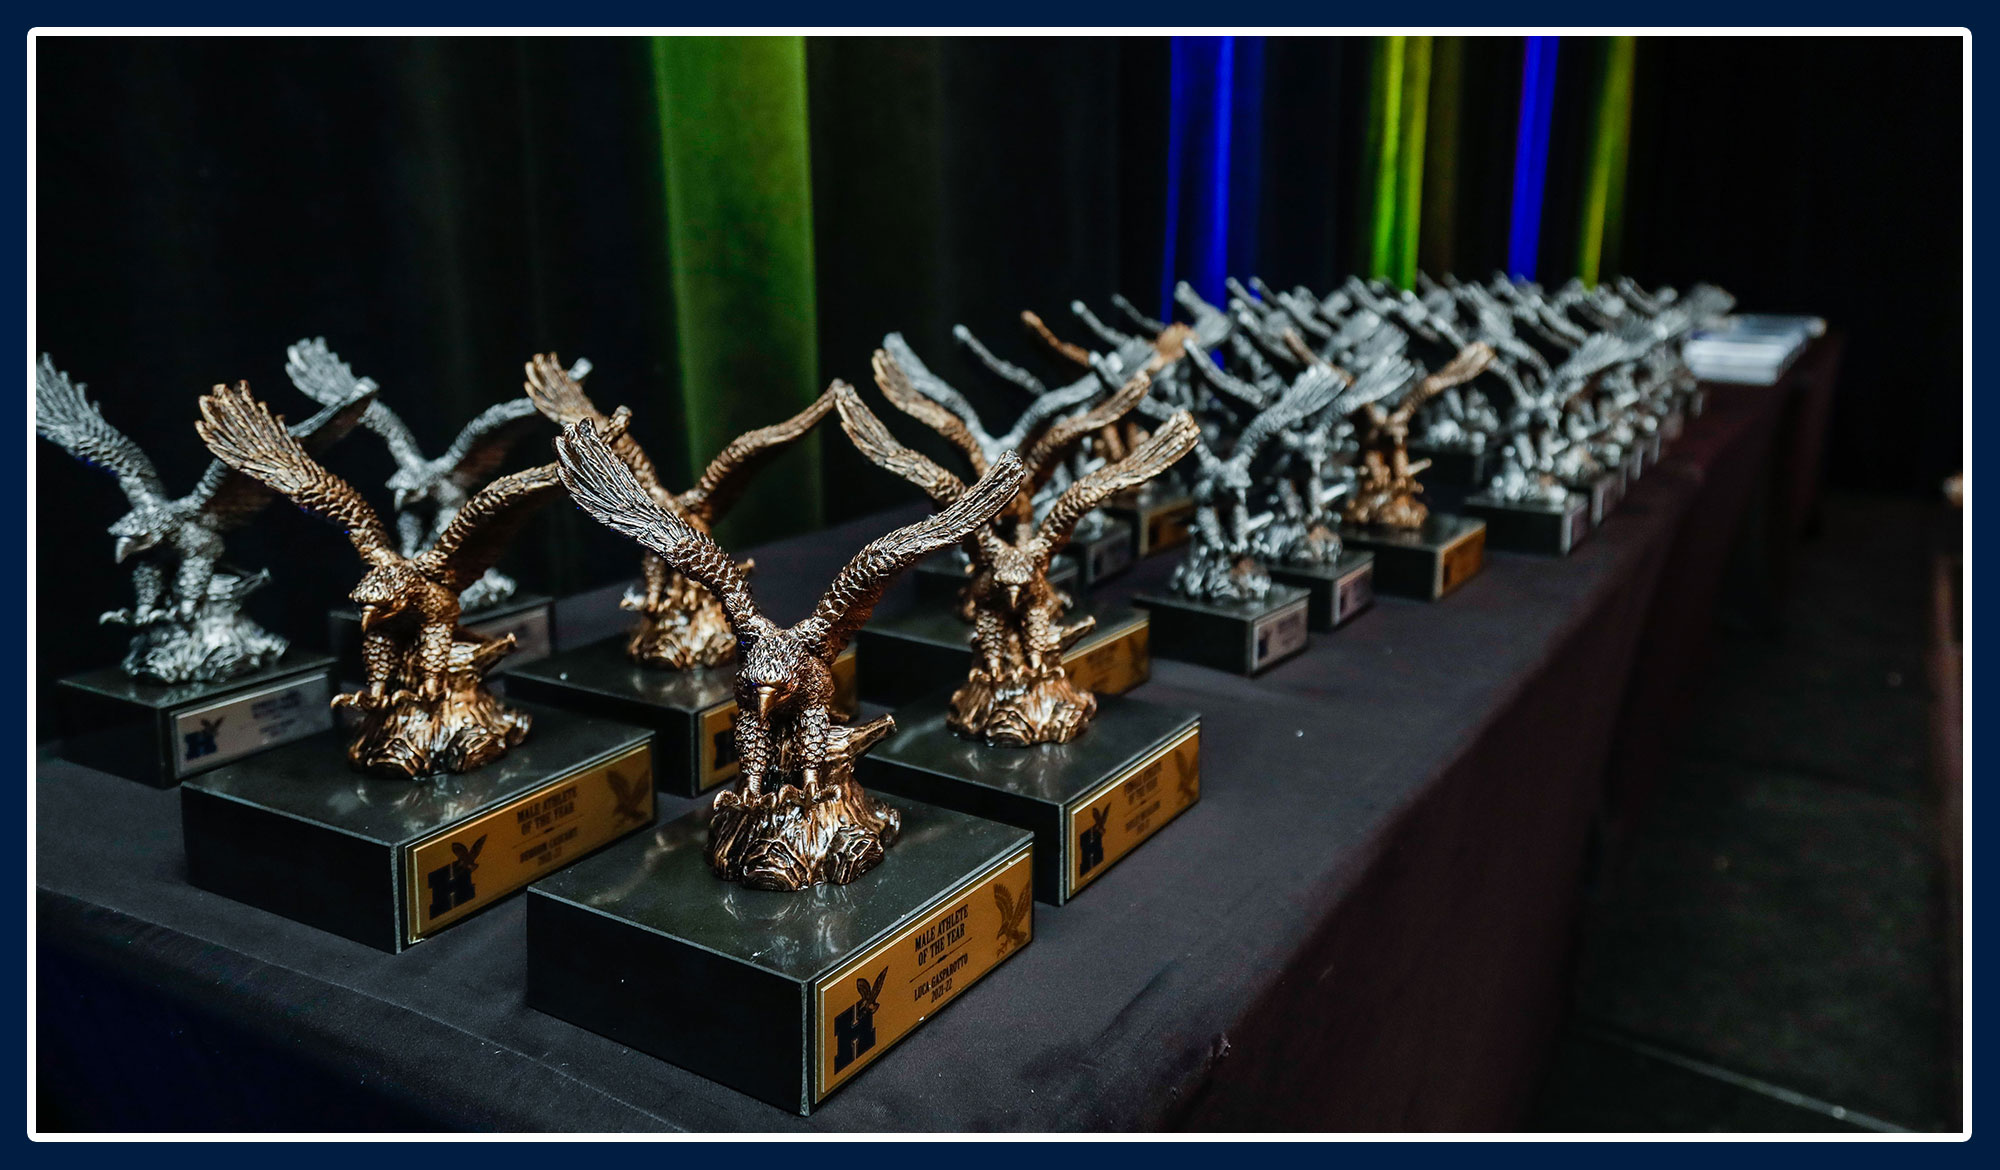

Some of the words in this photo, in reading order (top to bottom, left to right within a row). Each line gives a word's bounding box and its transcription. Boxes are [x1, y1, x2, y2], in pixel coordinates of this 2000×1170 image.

[517, 802, 541, 823] MALE
[535, 812, 552, 829] THE
[428, 864, 475, 920] H
[915, 927, 936, 952] MALE
[938, 905, 968, 936] ATHLETE
[919, 948, 929, 966] OF
[931, 937, 945, 957] THE
[948, 924, 965, 946] YEAR
[915, 982, 930, 1001] LUCA
[932, 954, 968, 988] GASPAROTTO
[932, 979, 953, 1002] 2021-22
[834, 1002, 876, 1075] H
